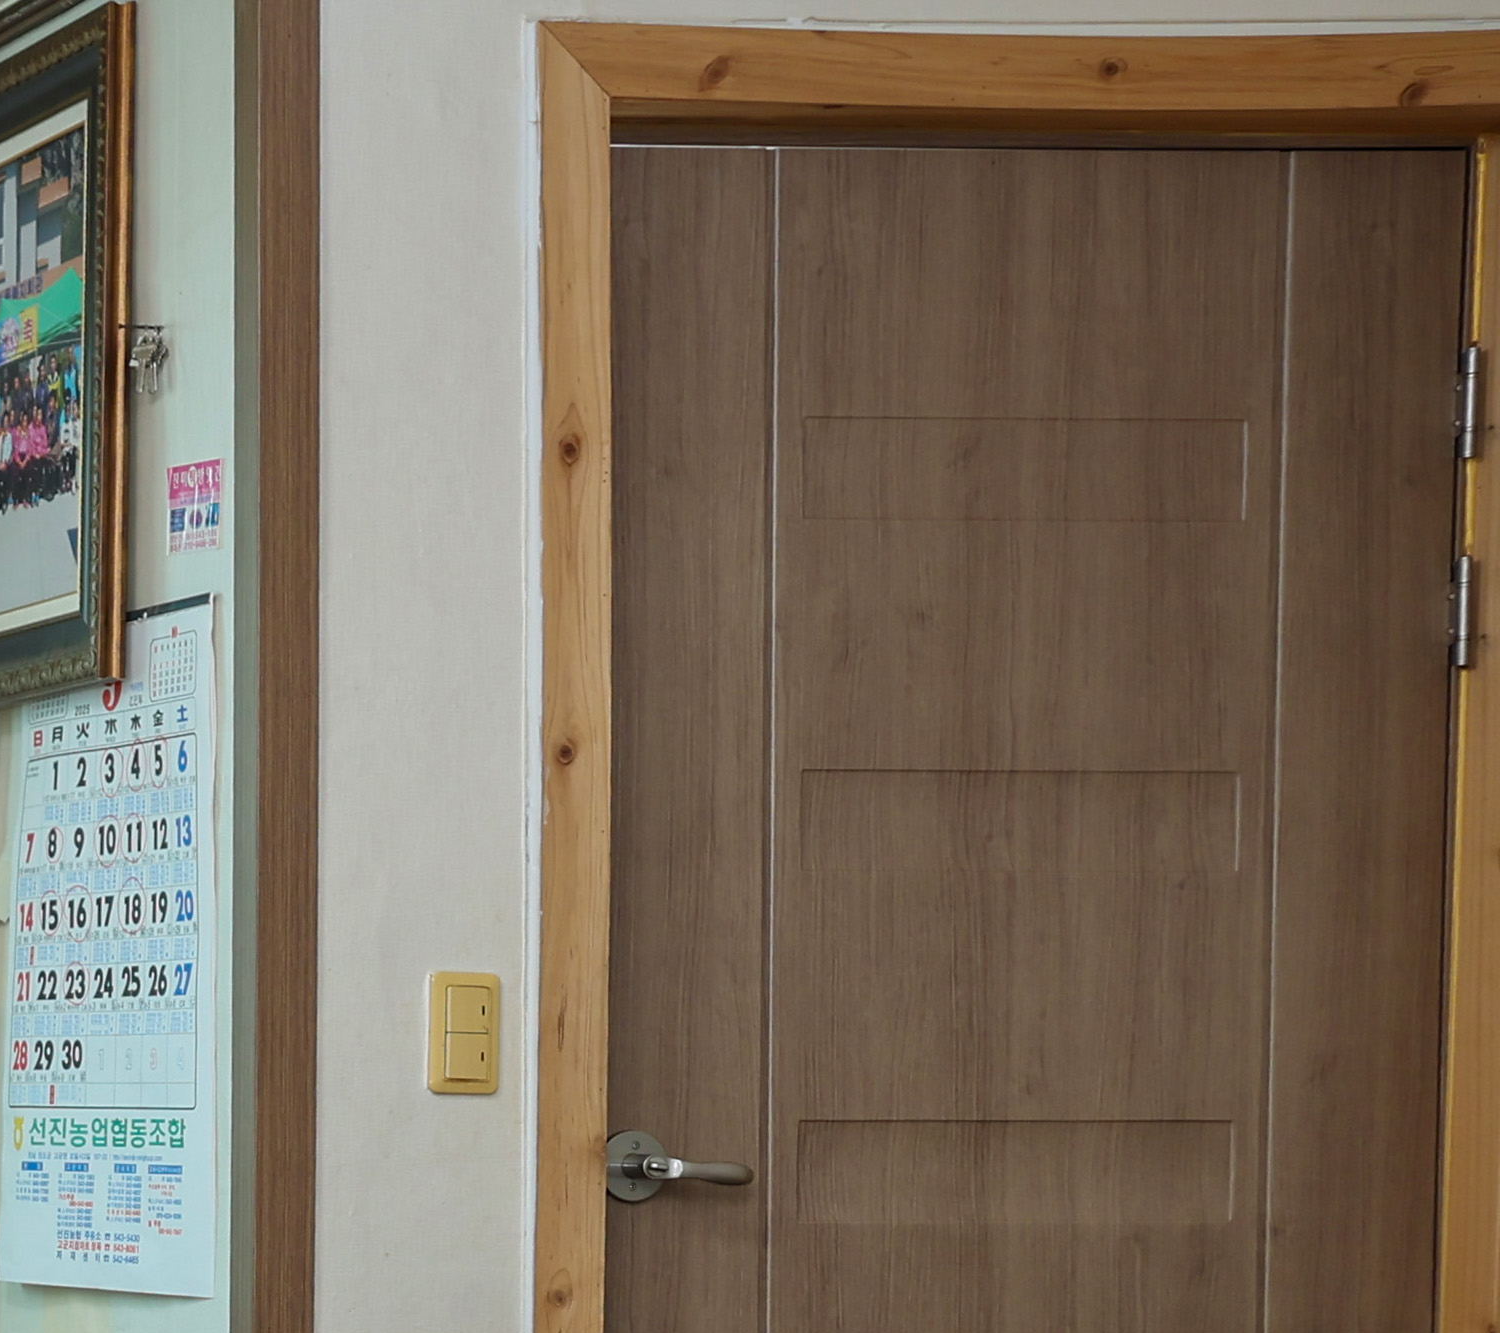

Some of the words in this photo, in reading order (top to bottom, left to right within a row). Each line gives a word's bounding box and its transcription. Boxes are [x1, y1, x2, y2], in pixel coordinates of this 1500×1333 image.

[33, 730, 43, 748] 日
[52, 726, 63, 743] 月
[76, 722, 90, 739] 火
[104, 718, 117, 735] 水
[130, 714, 141, 731] 木
[152, 709, 164, 727] 金
[177, 705, 188, 723] 土
[75, 703, 91, 716] 2025
[53, 760, 59, 790] 1
[76, 757, 86, 787] 2
[104, 753, 114, 783] 3
[131, 748, 140, 780] 4
[154, 744, 163, 777] 5
[178, 740, 188, 772] 6
[25, 833, 35, 864] 7
[48, 827, 57, 859] 8
[74, 827, 85, 858] 9
[98, 824, 116, 856] 10
[126, 821, 142, 853] 11
[152, 818, 168, 850] 12
[175, 814, 192, 847] 13
[20, 901, 33, 933] 14
[41, 899, 58, 931] 15
[68, 898, 87, 929] 16
[96, 895, 115, 927] 17
[124, 893, 142, 925] 18
[151, 891, 168, 924] 19
[175, 889, 194, 922] 20
[17, 971, 31, 1002] 21
[37, 970, 57, 1000] 22
[65, 969, 86, 1000] 23
[94, 967, 114, 998] 24
[121, 965, 141, 997] 25
[148, 964, 168, 997] 26
[174, 963, 194, 996] 27
[12, 1040, 28, 1071] 28
[33, 1039, 54, 1071] 29
[61, 1039, 83, 1070] 30
[29, 1117, 187, 1148] 선진농업협동조합
[84, 1230, 101, 1241] 주유소
